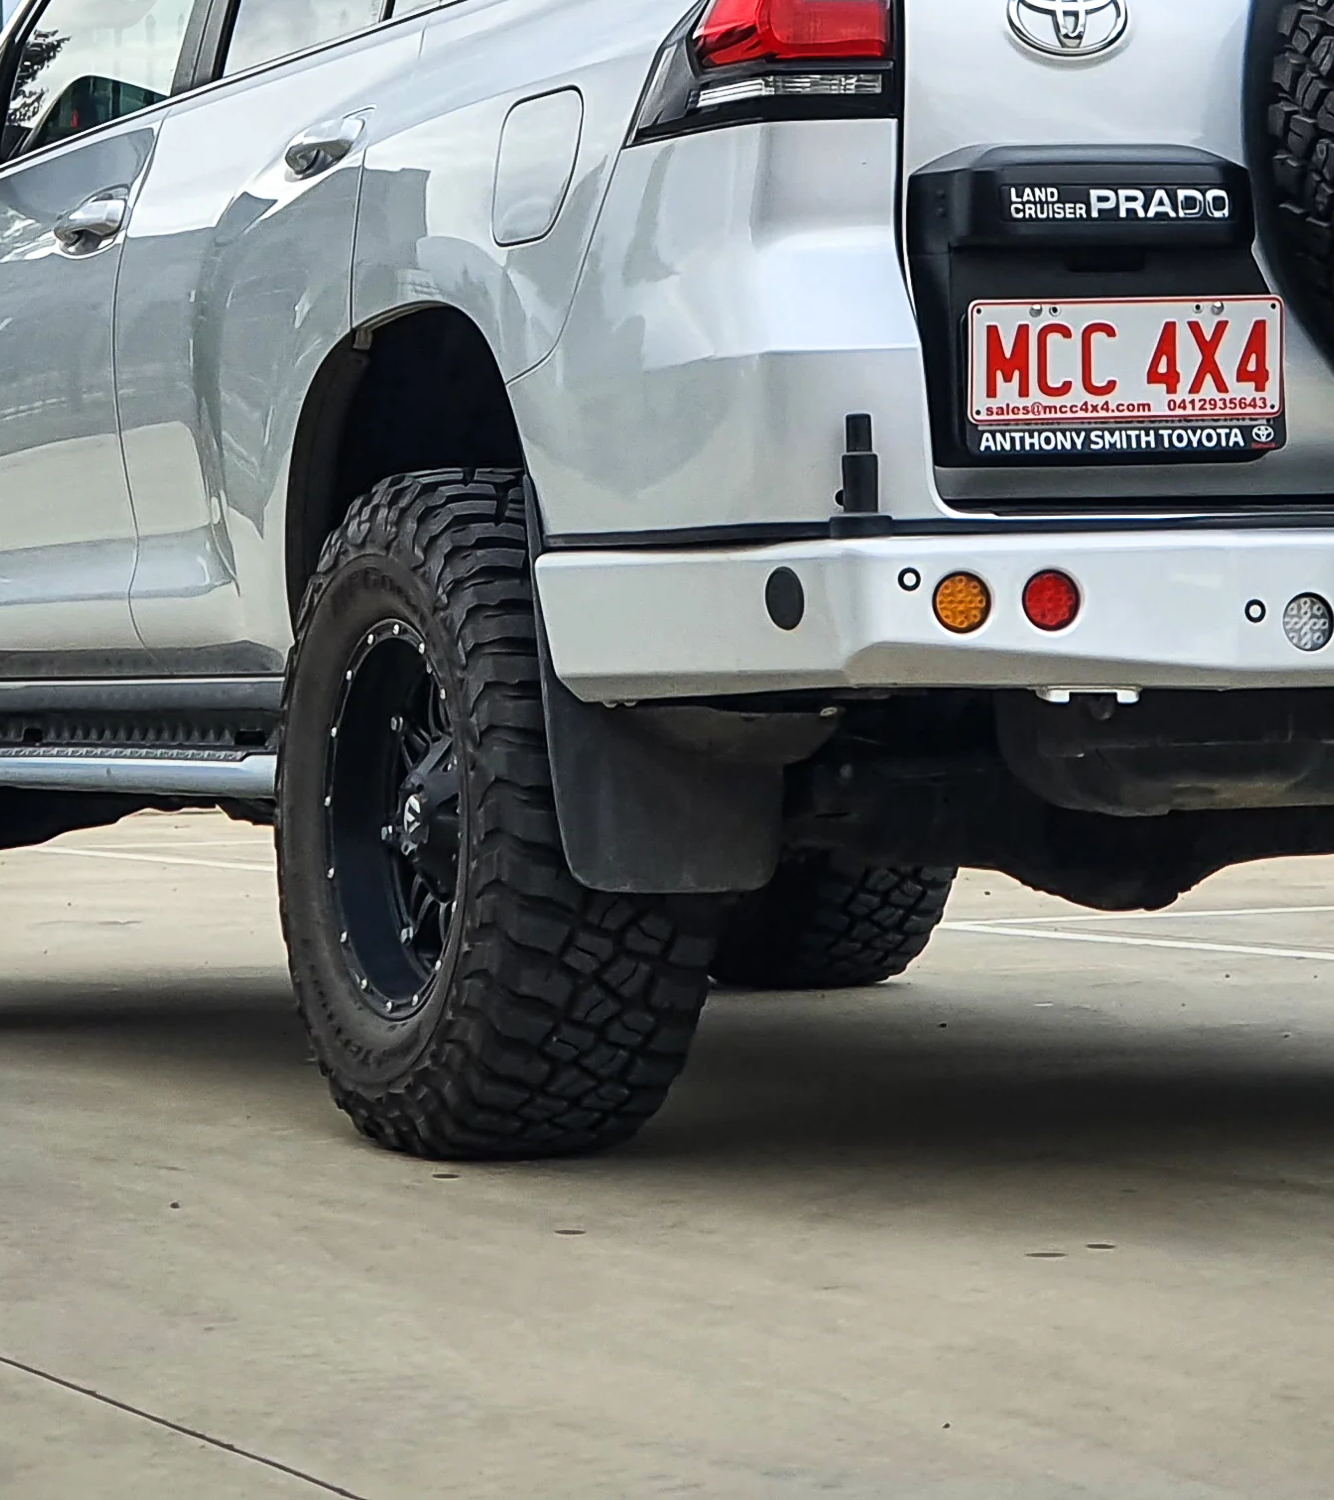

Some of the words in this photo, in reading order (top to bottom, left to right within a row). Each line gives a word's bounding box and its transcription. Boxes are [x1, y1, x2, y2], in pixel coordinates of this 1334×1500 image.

[1010, 187, 1059, 202] LAND
[1089, 188, 1229, 218] PRADO
[1010, 203, 1087, 218] CRUISER
[986, 321, 1117, 399] MCC
[1146, 319, 1270, 397] 4X4
[985, 400, 1152, 417] sales@mcc4x4.com
[1167, 396, 1268, 412] 0412935643
[979, 431, 1085, 451] ANTHONY
[1090, 429, 1155, 450] SMITH
[1159, 428, 1245, 449] TOYOTA
